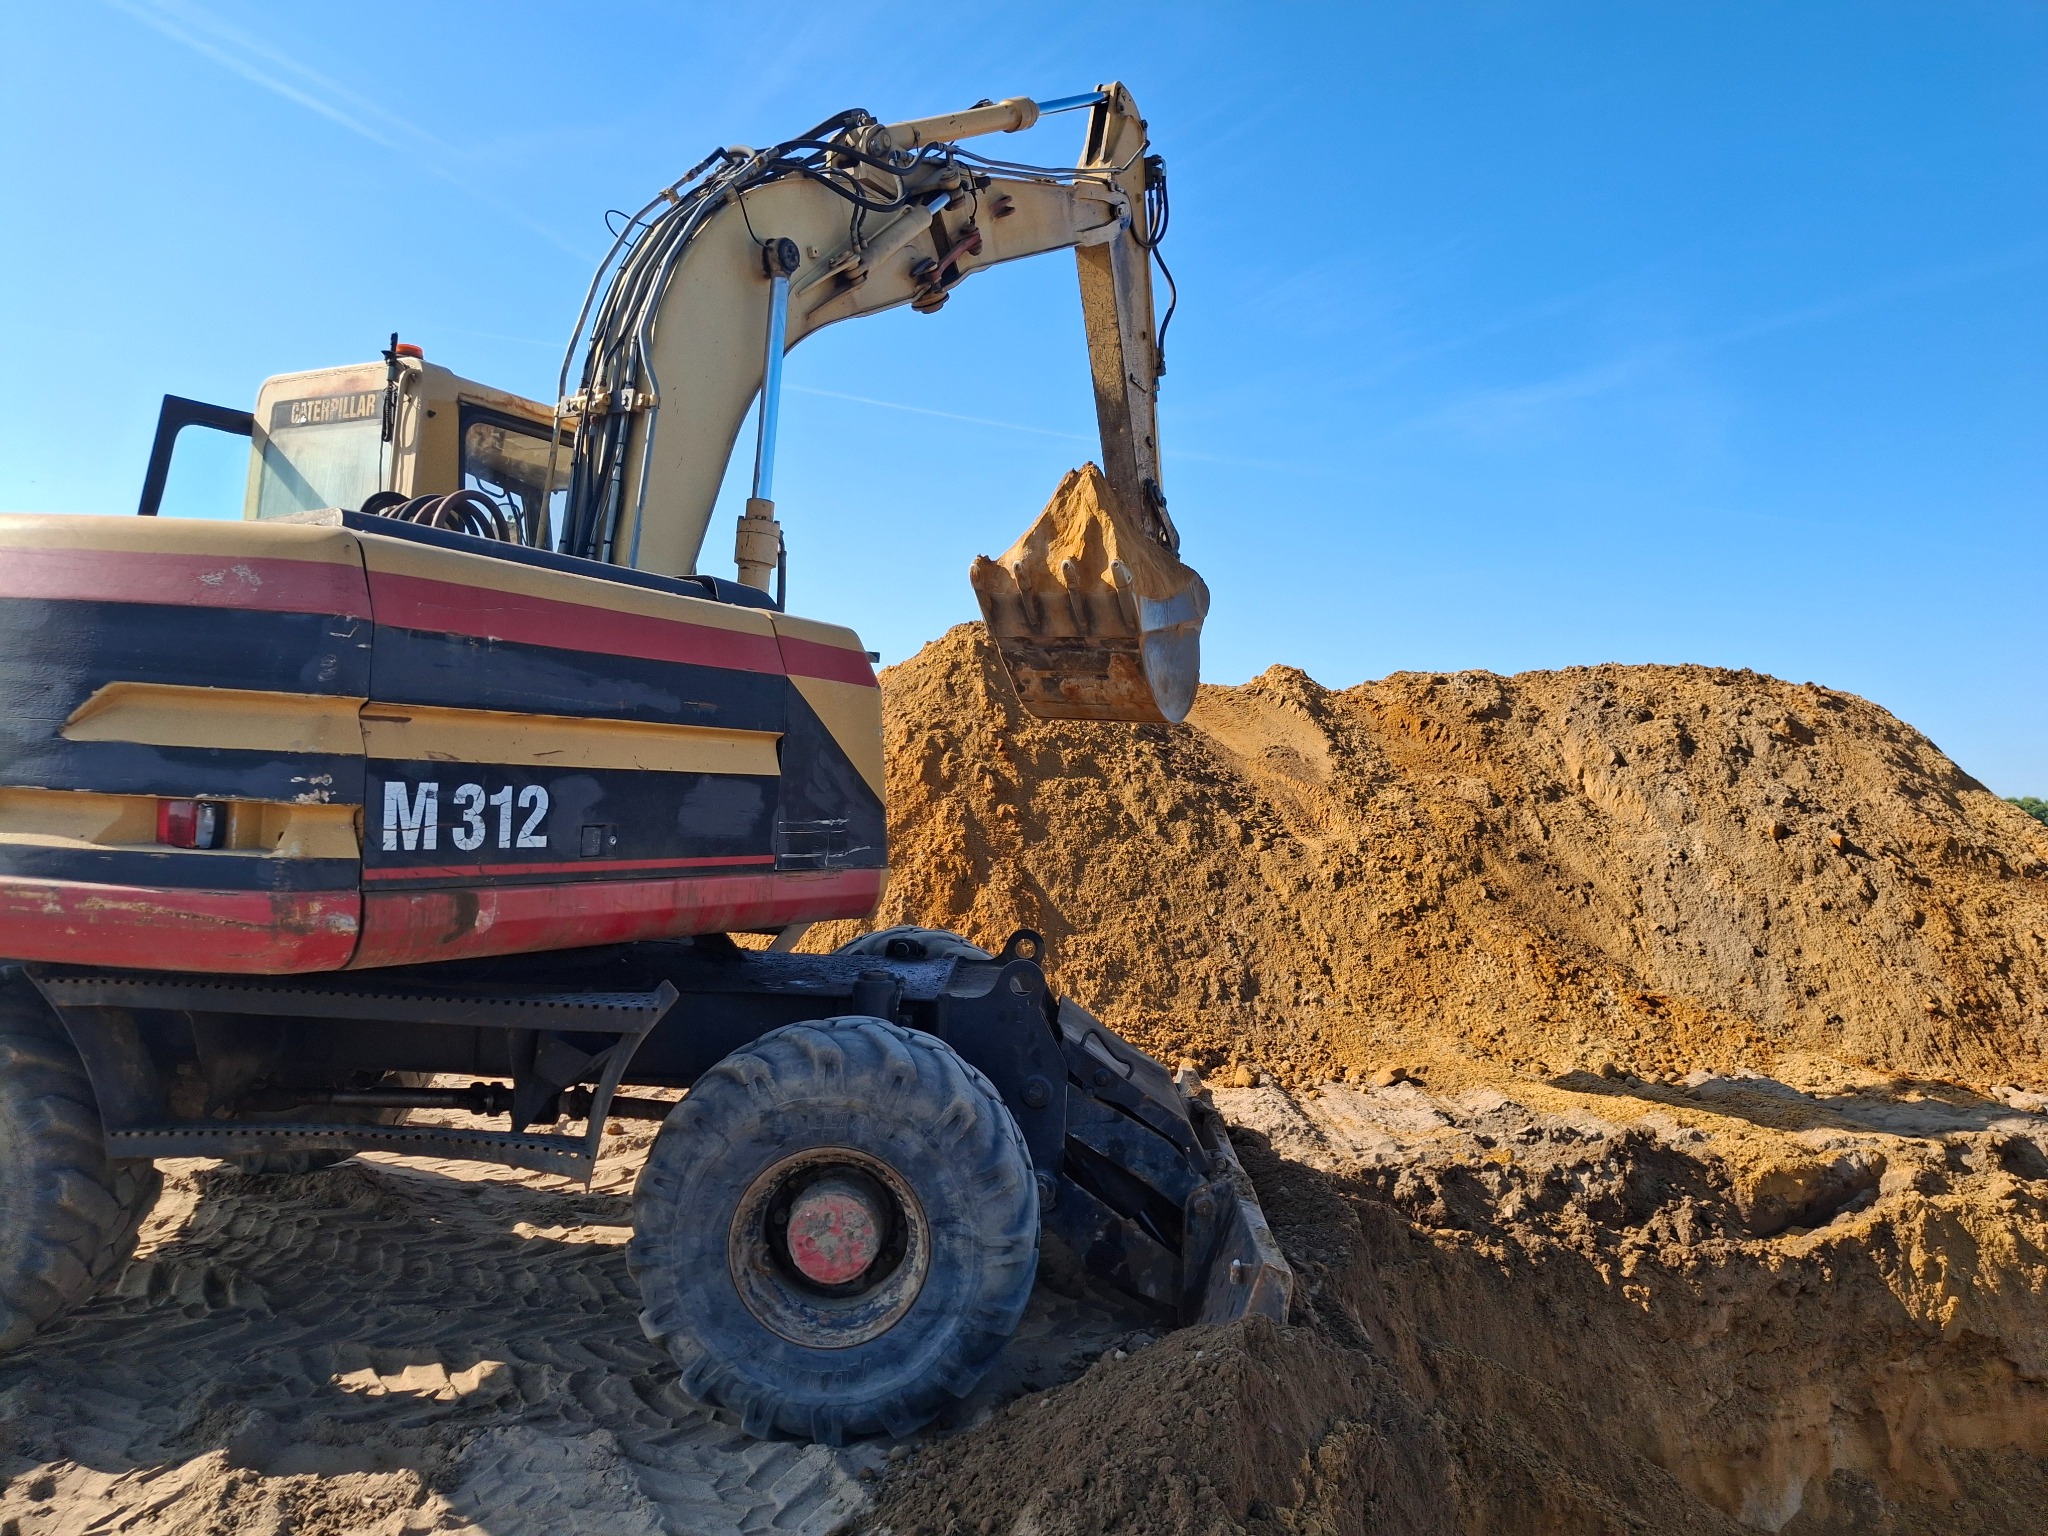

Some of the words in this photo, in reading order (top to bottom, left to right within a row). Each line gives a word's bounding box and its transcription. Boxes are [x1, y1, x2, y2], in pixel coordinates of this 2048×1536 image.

[291, 394, 376, 424] CATERPILLAR
[382, 781, 439, 851] M
[452, 783, 549, 850] 312
